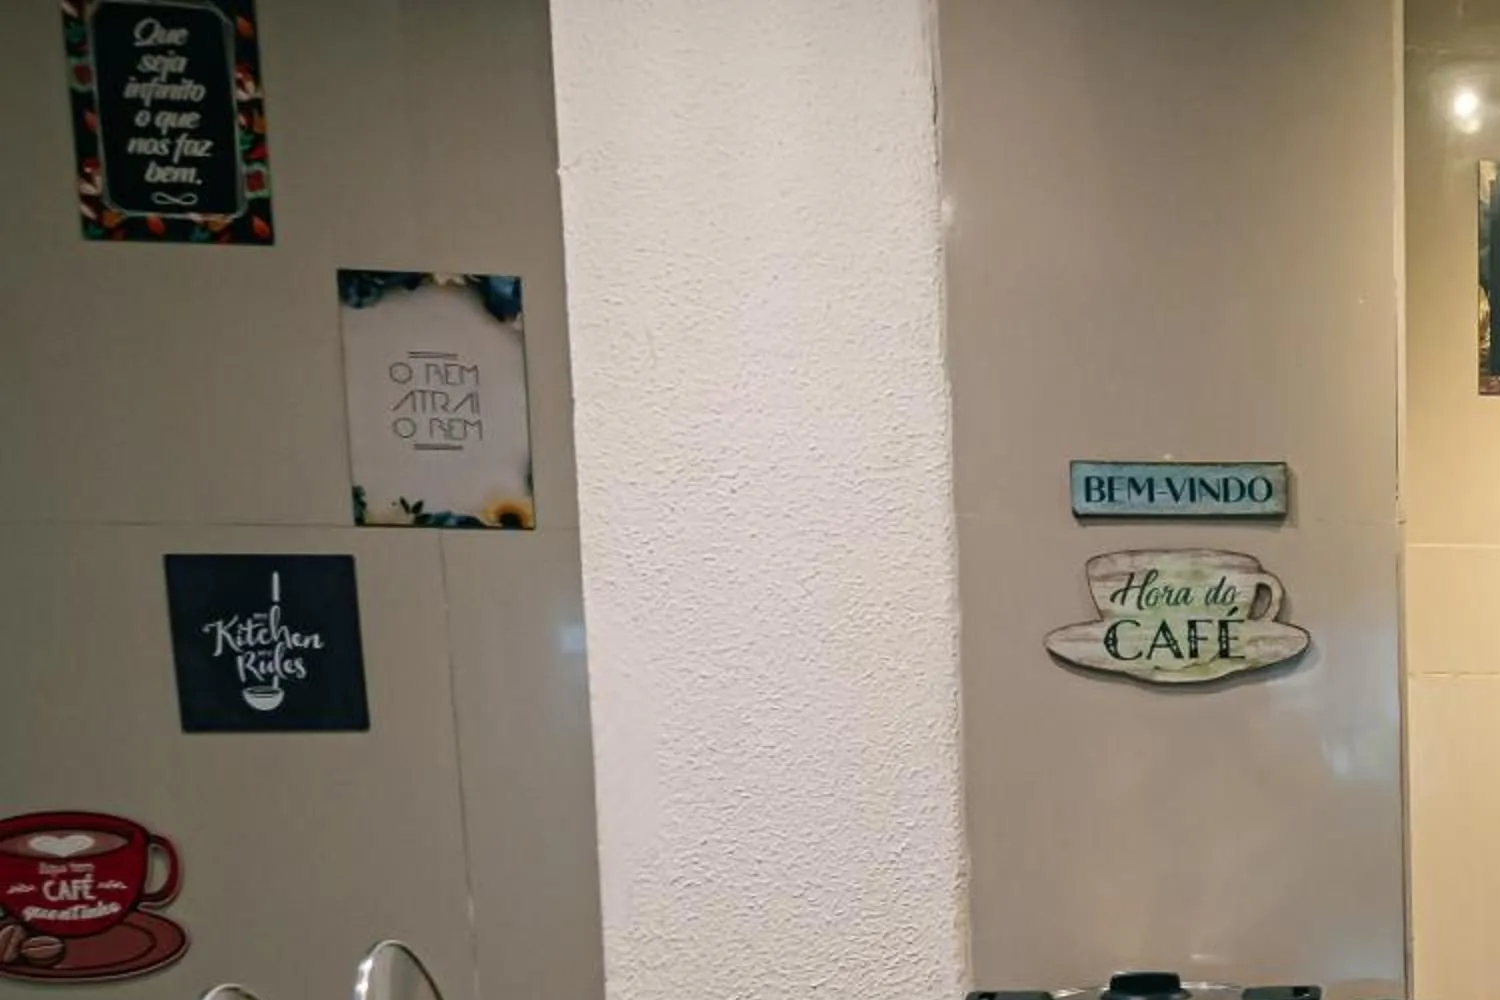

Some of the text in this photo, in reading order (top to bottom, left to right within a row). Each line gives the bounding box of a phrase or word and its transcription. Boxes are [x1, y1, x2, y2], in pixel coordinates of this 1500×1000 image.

[133, 18, 189, 47] Que
[137, 50, 188, 82] seja
[123, 77, 206, 107] infinito
[135, 110, 201, 135] o que
[127, 133, 214, 164] nos faz
[389, 362, 480, 386] O BEM
[392, 389, 481, 414] ATRAI
[392, 416, 484, 441] O BEM
[1084, 475, 1274, 504] BEM-VINDO
[1109, 568, 1239, 611] Hora do
[202, 604, 325, 657] Kitchen
[1103, 606, 1246, 661] CAFÉ
[236, 642, 307, 682] Rules
[42, 873, 97, 902] CAFÉ
